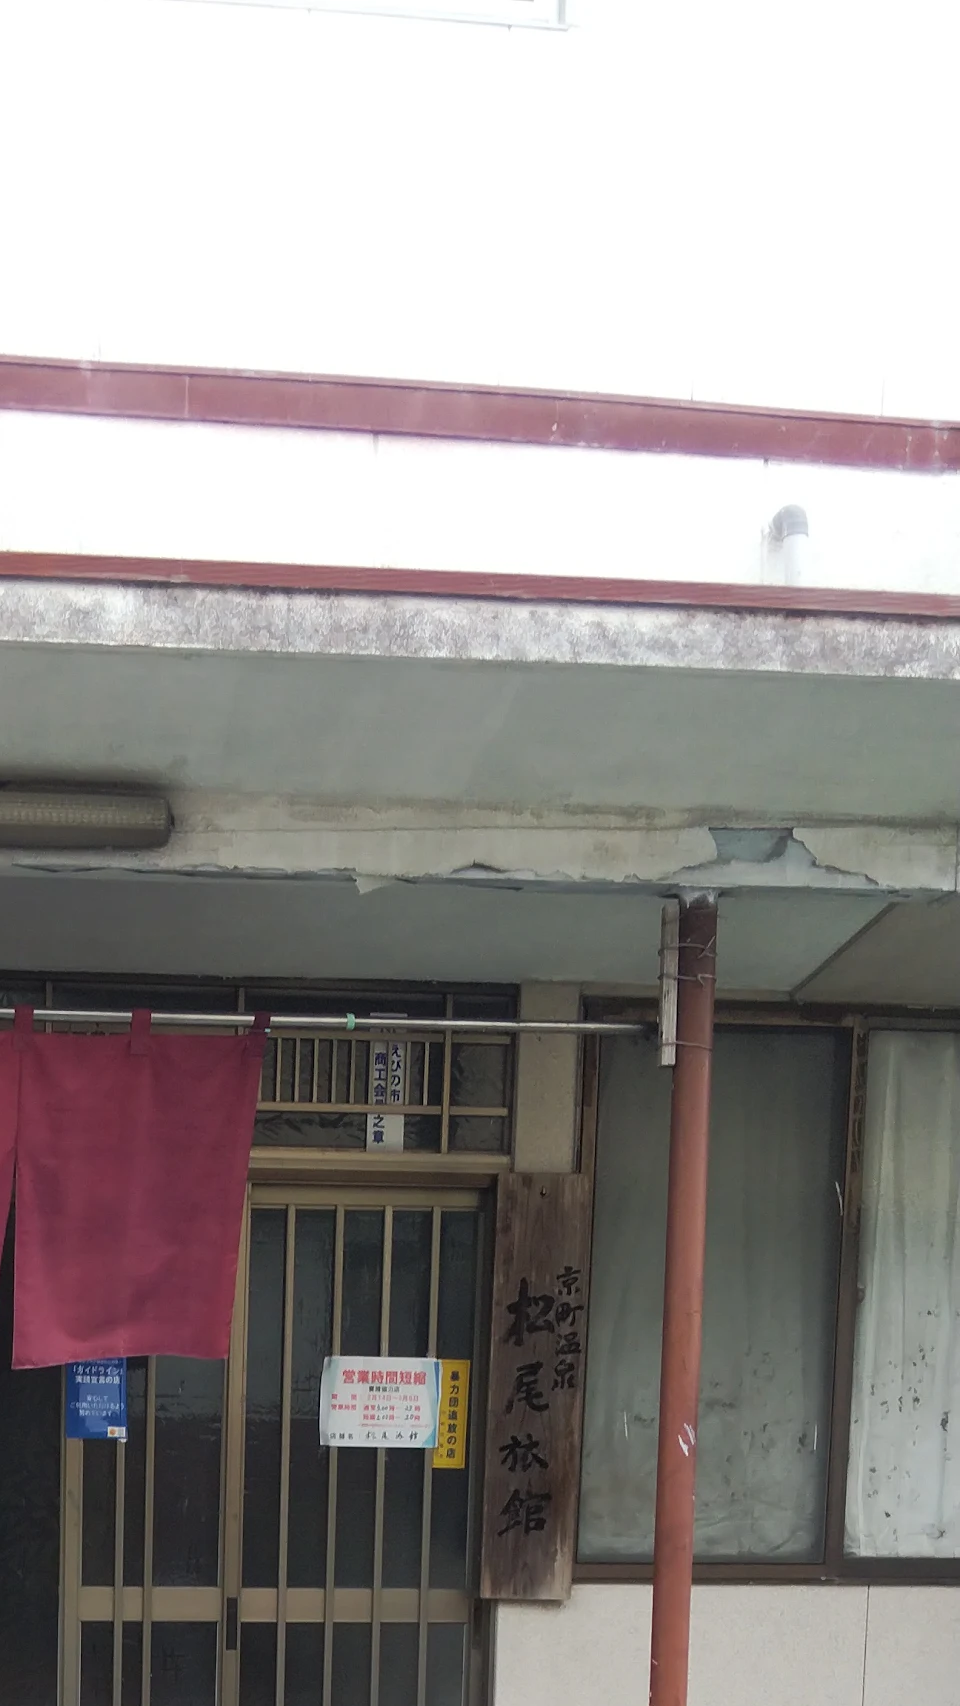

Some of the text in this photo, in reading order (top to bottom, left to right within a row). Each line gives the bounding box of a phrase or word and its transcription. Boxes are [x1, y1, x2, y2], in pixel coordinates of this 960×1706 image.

[391, 1043, 402, 1102] えびの市
[552, 1266, 584, 1391] 京町温泉
[342, 1369, 427, 1385] 営業時間短縮
[446, 1370, 460, 1459] 暴力団追放の店
[497, 1277, 555, 1537] 松尾旅館
